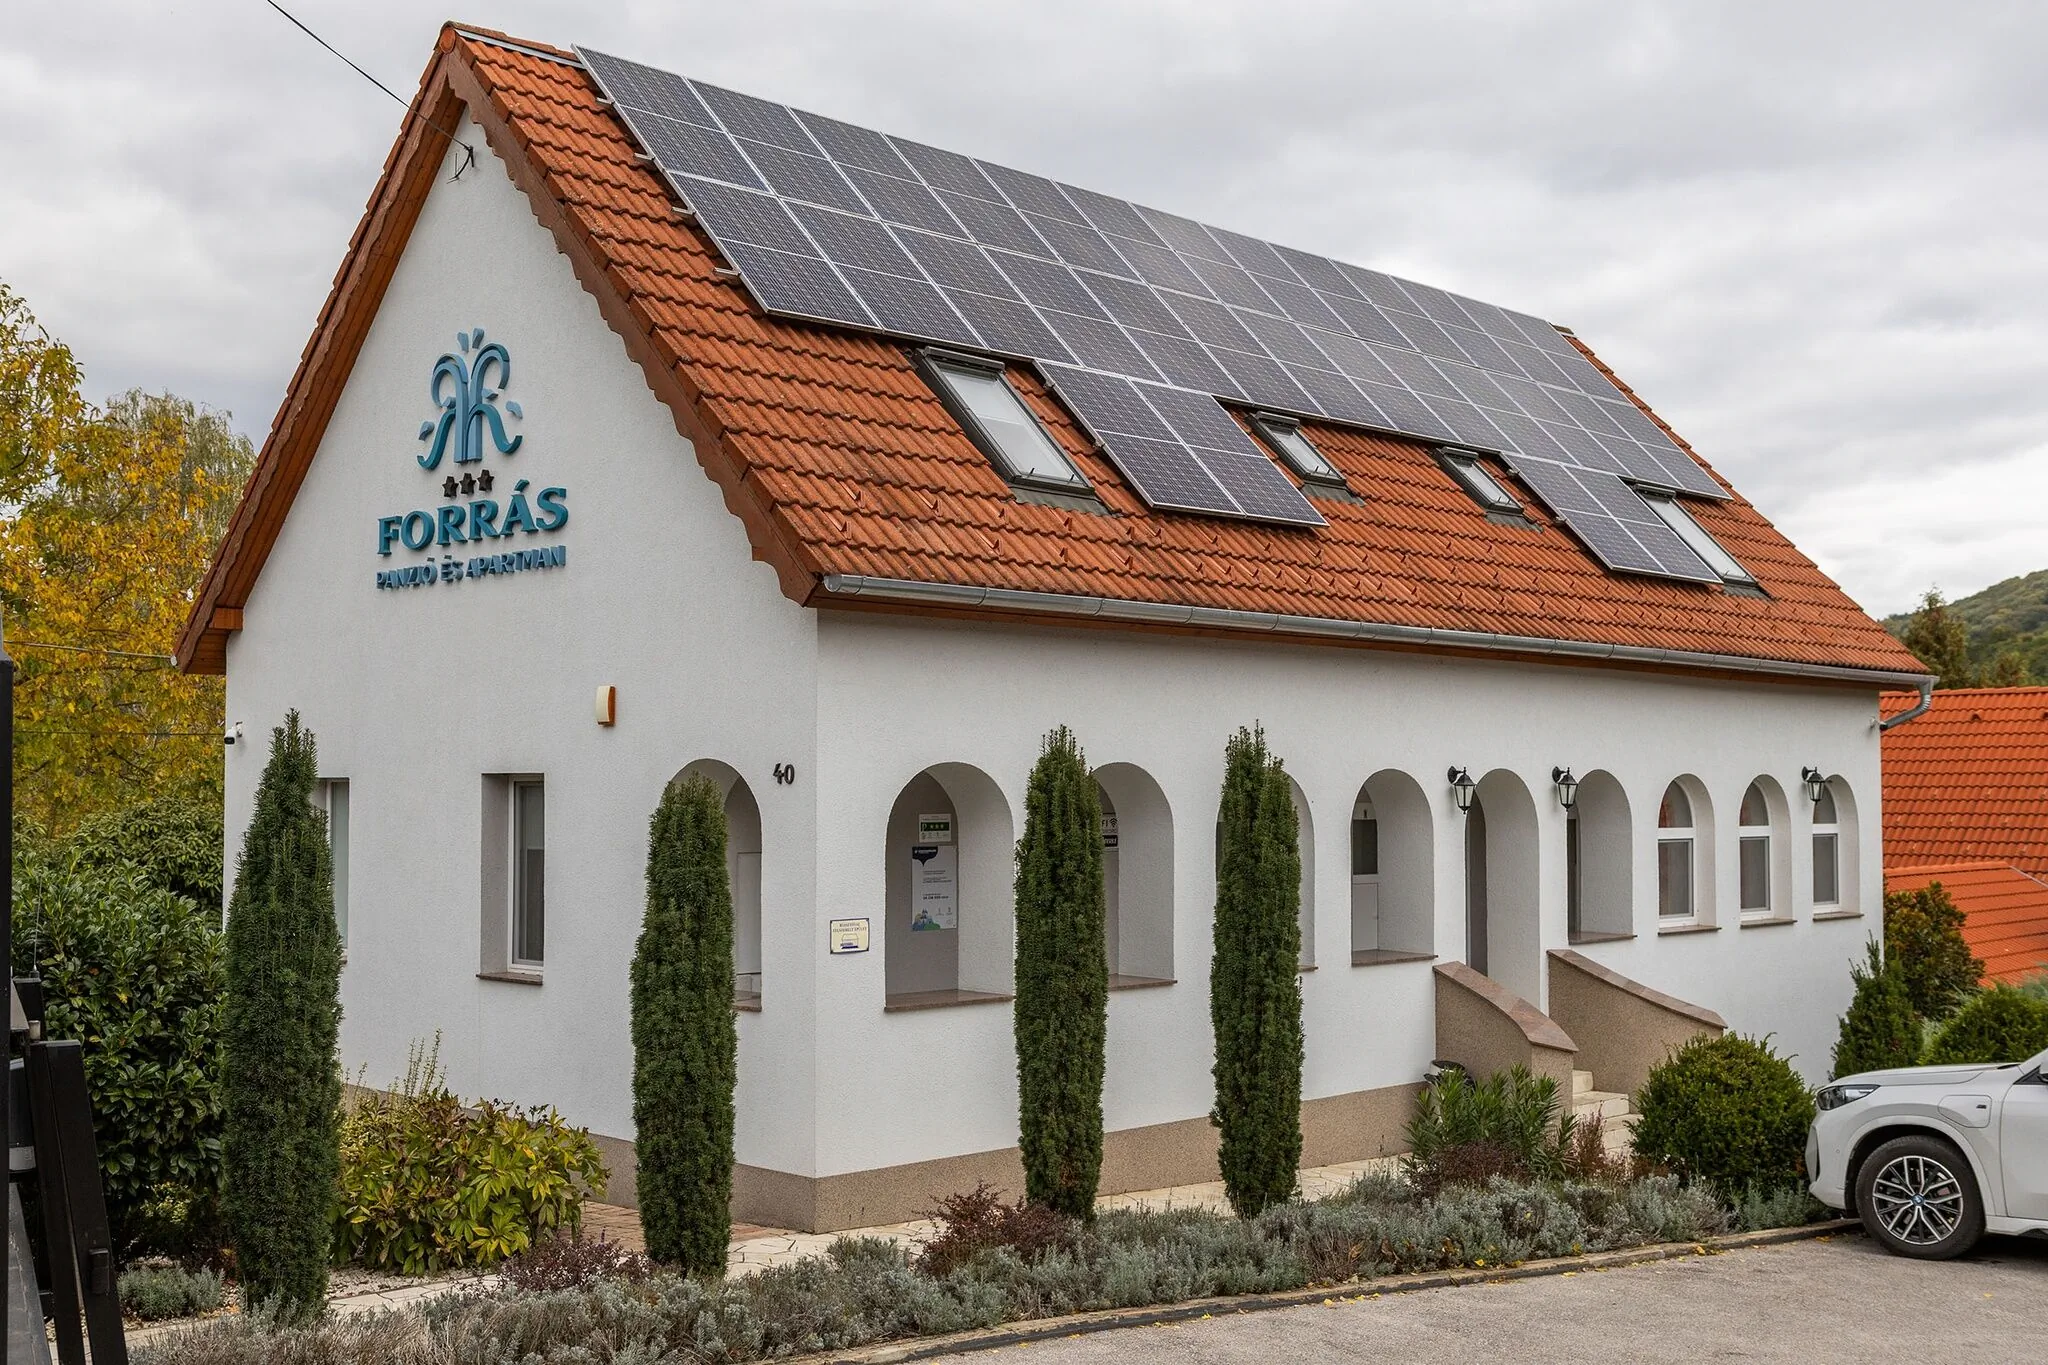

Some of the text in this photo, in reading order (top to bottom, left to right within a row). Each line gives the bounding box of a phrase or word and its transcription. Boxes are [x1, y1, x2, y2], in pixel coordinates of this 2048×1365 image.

[377, 479, 569, 556] FORRÁS
[376, 545, 566, 589] PANZIÓ ÉS APARTMAN
[773, 763, 795, 785] 40
